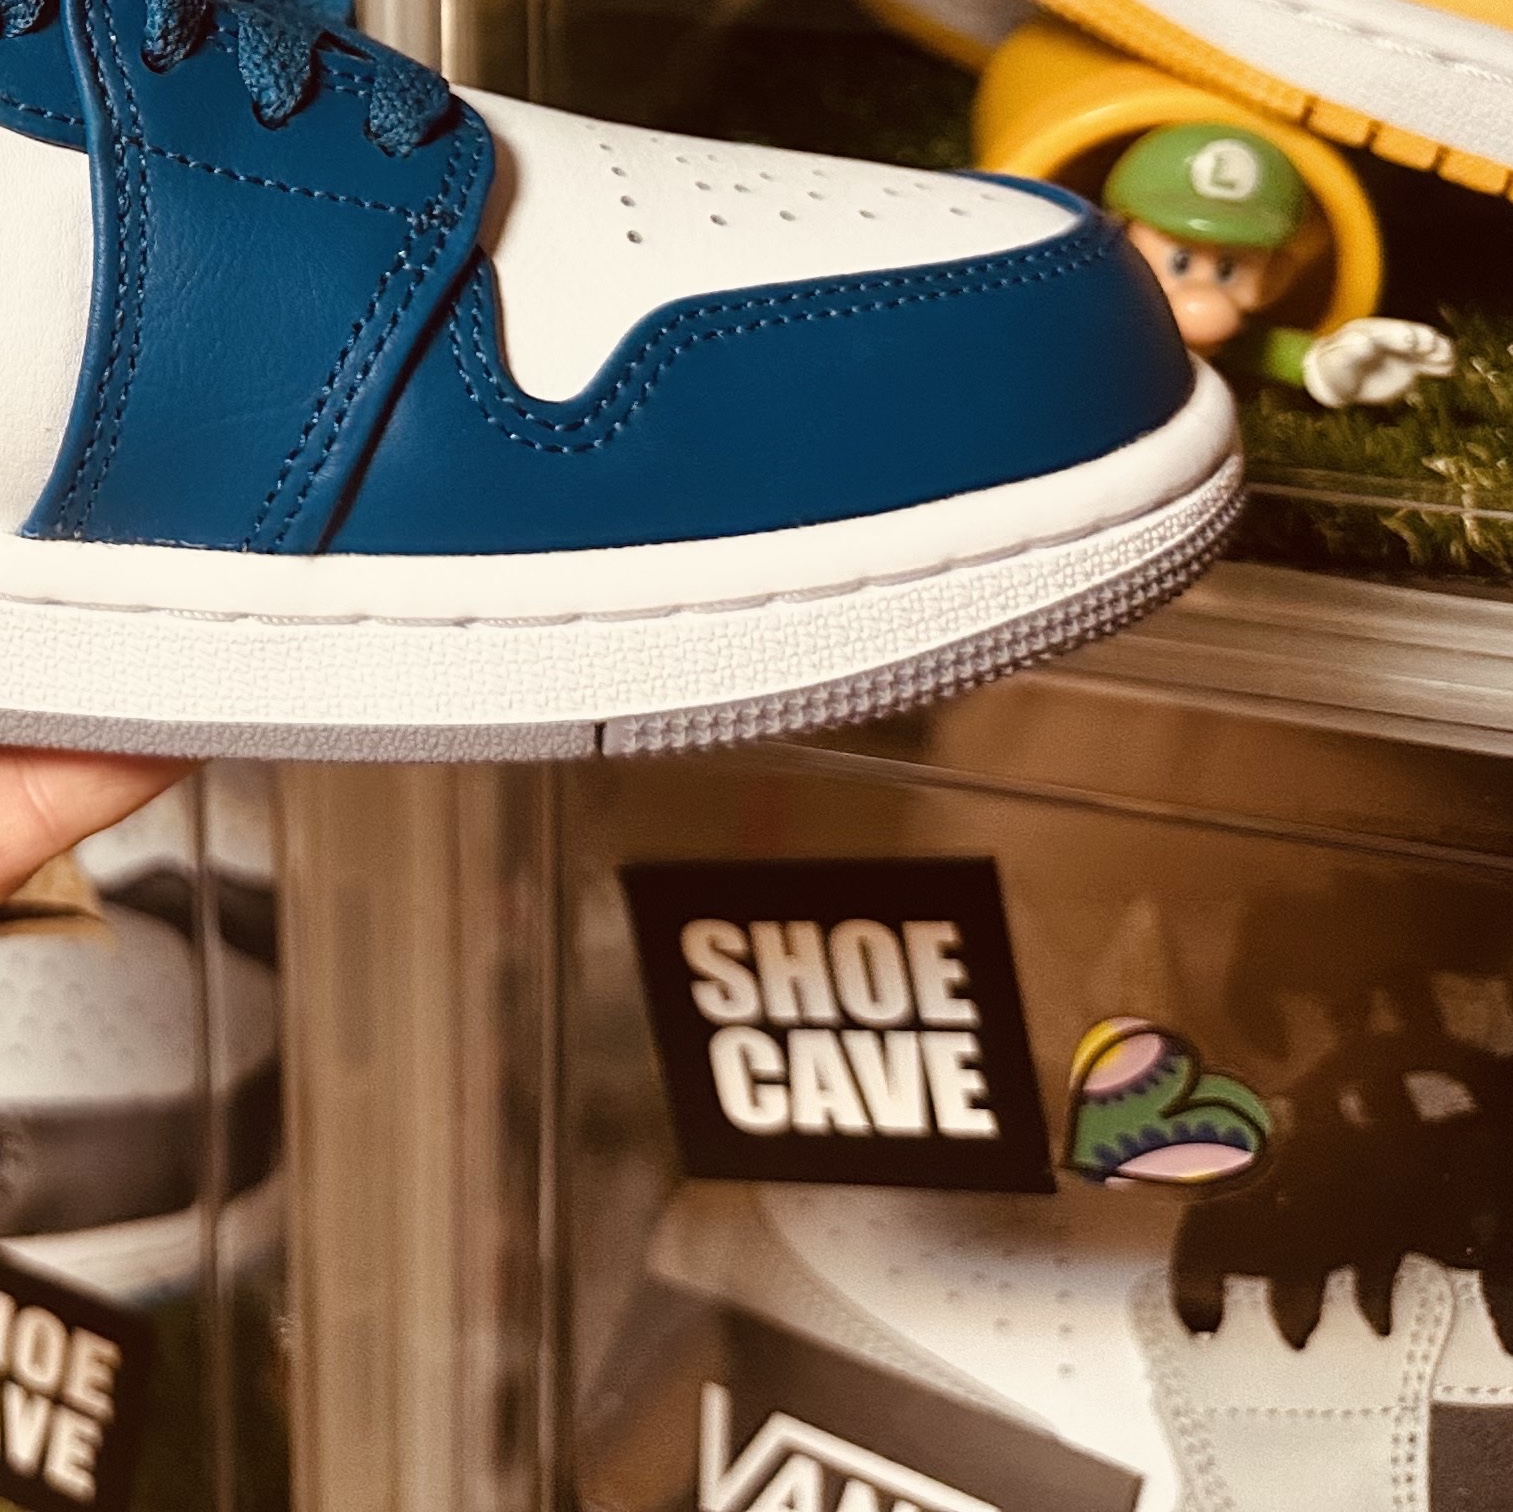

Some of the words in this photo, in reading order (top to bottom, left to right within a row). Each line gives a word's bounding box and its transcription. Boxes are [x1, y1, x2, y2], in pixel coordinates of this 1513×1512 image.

[1210, 151, 1238, 190] L
[680, 918, 981, 1028] SHOE
[709, 1025, 1000, 1138] CAVE
